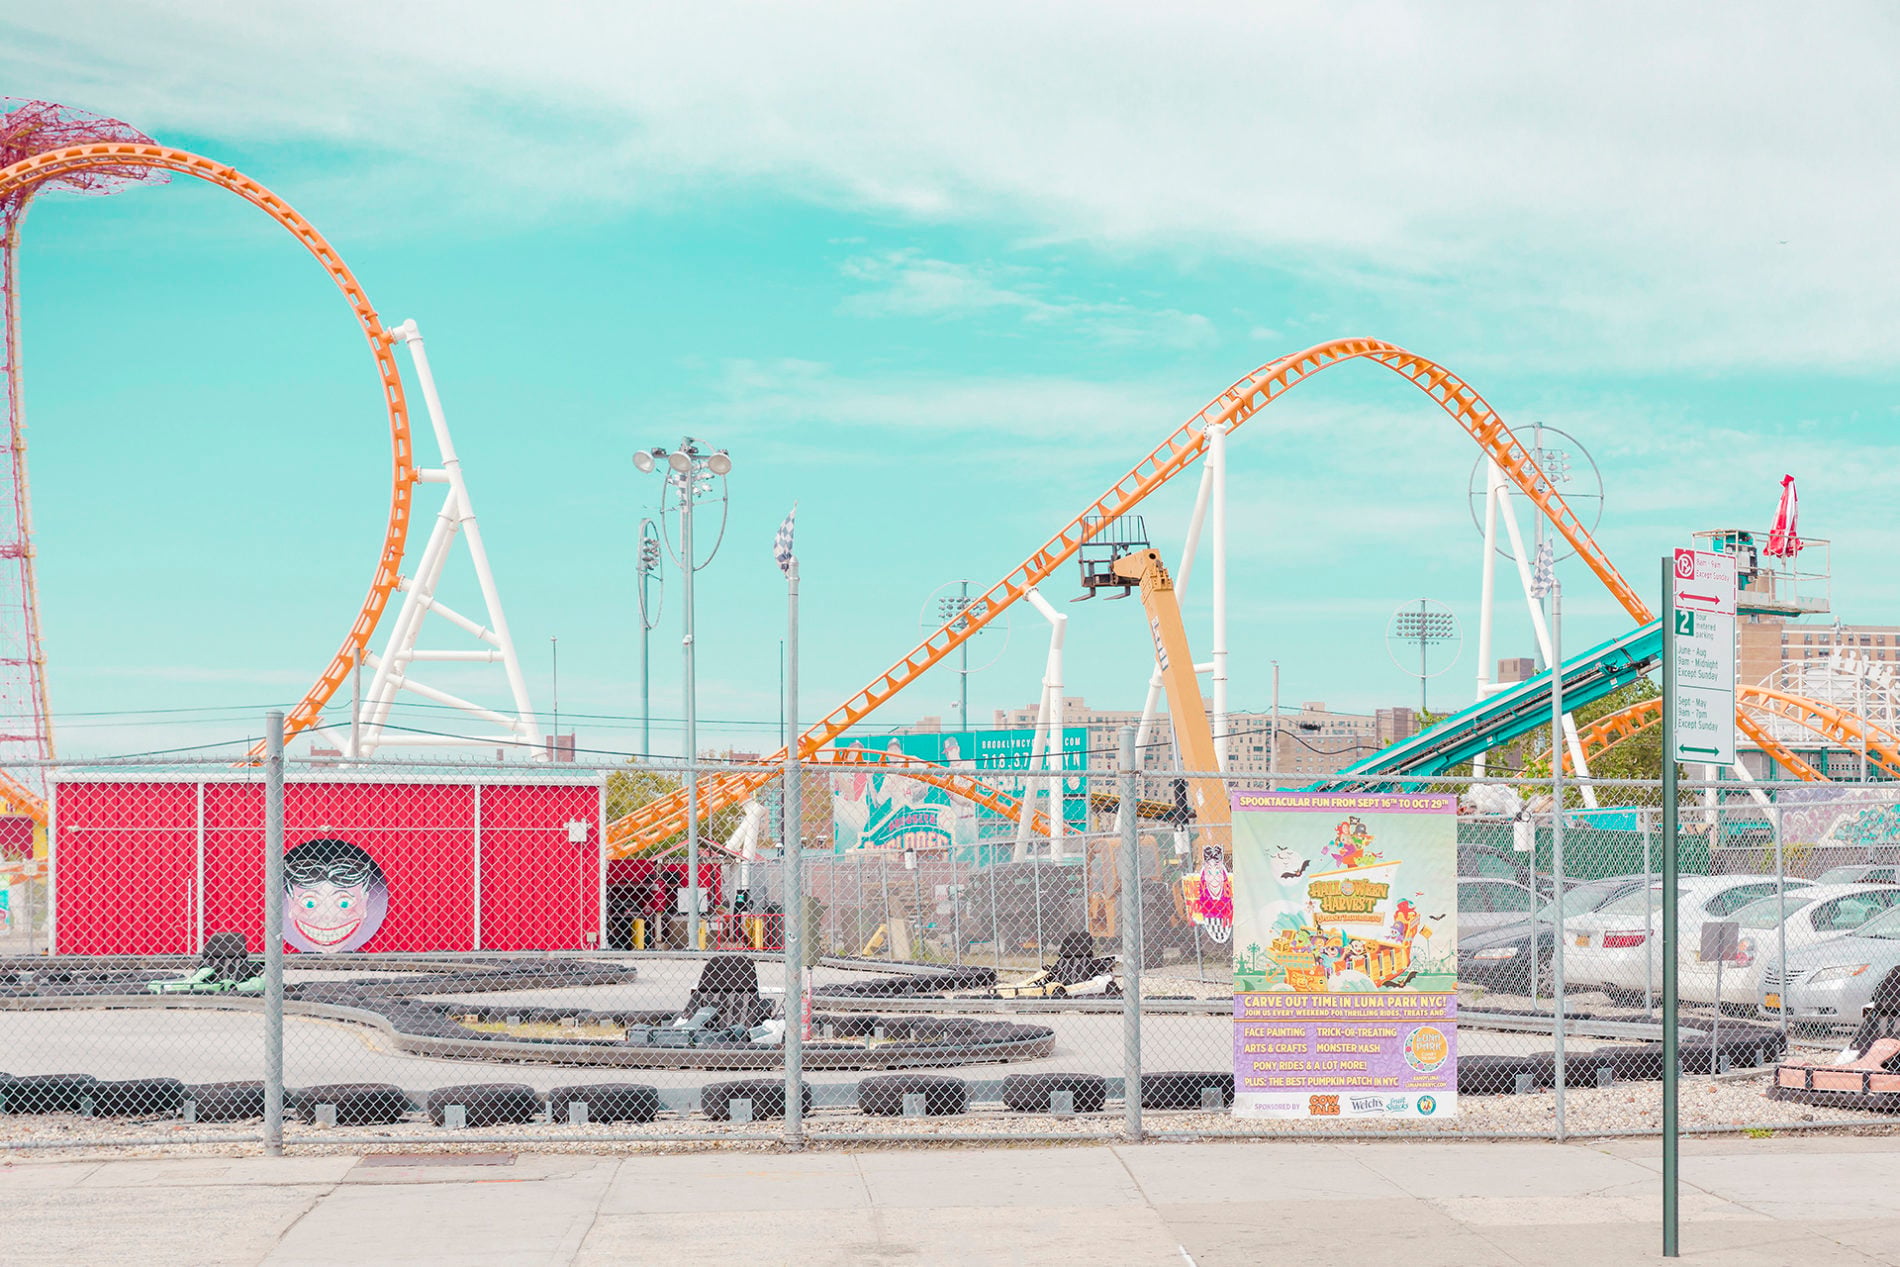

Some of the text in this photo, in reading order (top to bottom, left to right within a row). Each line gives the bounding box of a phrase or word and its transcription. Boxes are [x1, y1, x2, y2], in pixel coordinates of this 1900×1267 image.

[1696, 569, 1730, 582] Except Sunday
[1680, 611, 1690, 634] 2
[1696, 622, 1717, 632] metered
[1696, 631, 1714, 641] parking
[1678, 646, 1691, 655] June
[1696, 647, 1707, 659] Aug
[1678, 656, 1690, 666] 9am
[1695, 658, 1719, 671] Midnight
[1678, 667, 1719, 682] Except Sunday
[1679, 695, 1691, 707] Sept
[1696, 698, 1708, 709] May
[1679, 707, 1690, 717] 9am
[1678, 718, 1719, 732] Except Sunday
[1239, 797, 1310, 808] SPOOKTACULAR
[1312, 797, 1330, 808] FUN
[1331, 797, 1356, 809] FROM
[1358, 798, 1380, 809] SEPT
[1399, 799, 1411, 809] TO
[1412, 799, 1430, 809] OCT
[1321, 896, 1376, 913] HARVEST
[1244, 996, 1447, 1008] CARVE OUT TIME IN LUNA PARK NYC!
[1245, 1009, 1261, 1017] JOIN
[1262, 1009, 1271, 1017] US
[1272, 1009, 1294, 1017] EVERY
[1296, 1009, 1330, 1017] WEEKEND
[1331, 1009, 1343, 1017] FOR
[1344, 1009, 1379, 1017] THRILLING
[1403, 1009, 1429, 1017] TREATS
[1244, 1027, 1306, 1038] FACE PAINTING
[1317, 1027, 1398, 1038] TRICK-OR-TREATING
[1244, 1043, 1308, 1053] ARTS & CRAFTS
[1316, 1043, 1381, 1053] MONSTER MASH
[1253, 1061, 1368, 1071] PONY RIDES & A LOT MORE!
[1244, 1076, 1400, 1087] PLUS: THE BEST PUMPKIN PATCH IN NYC
[1309, 1094, 1340, 1106] COW
[1308, 1104, 1341, 1116] TALES
